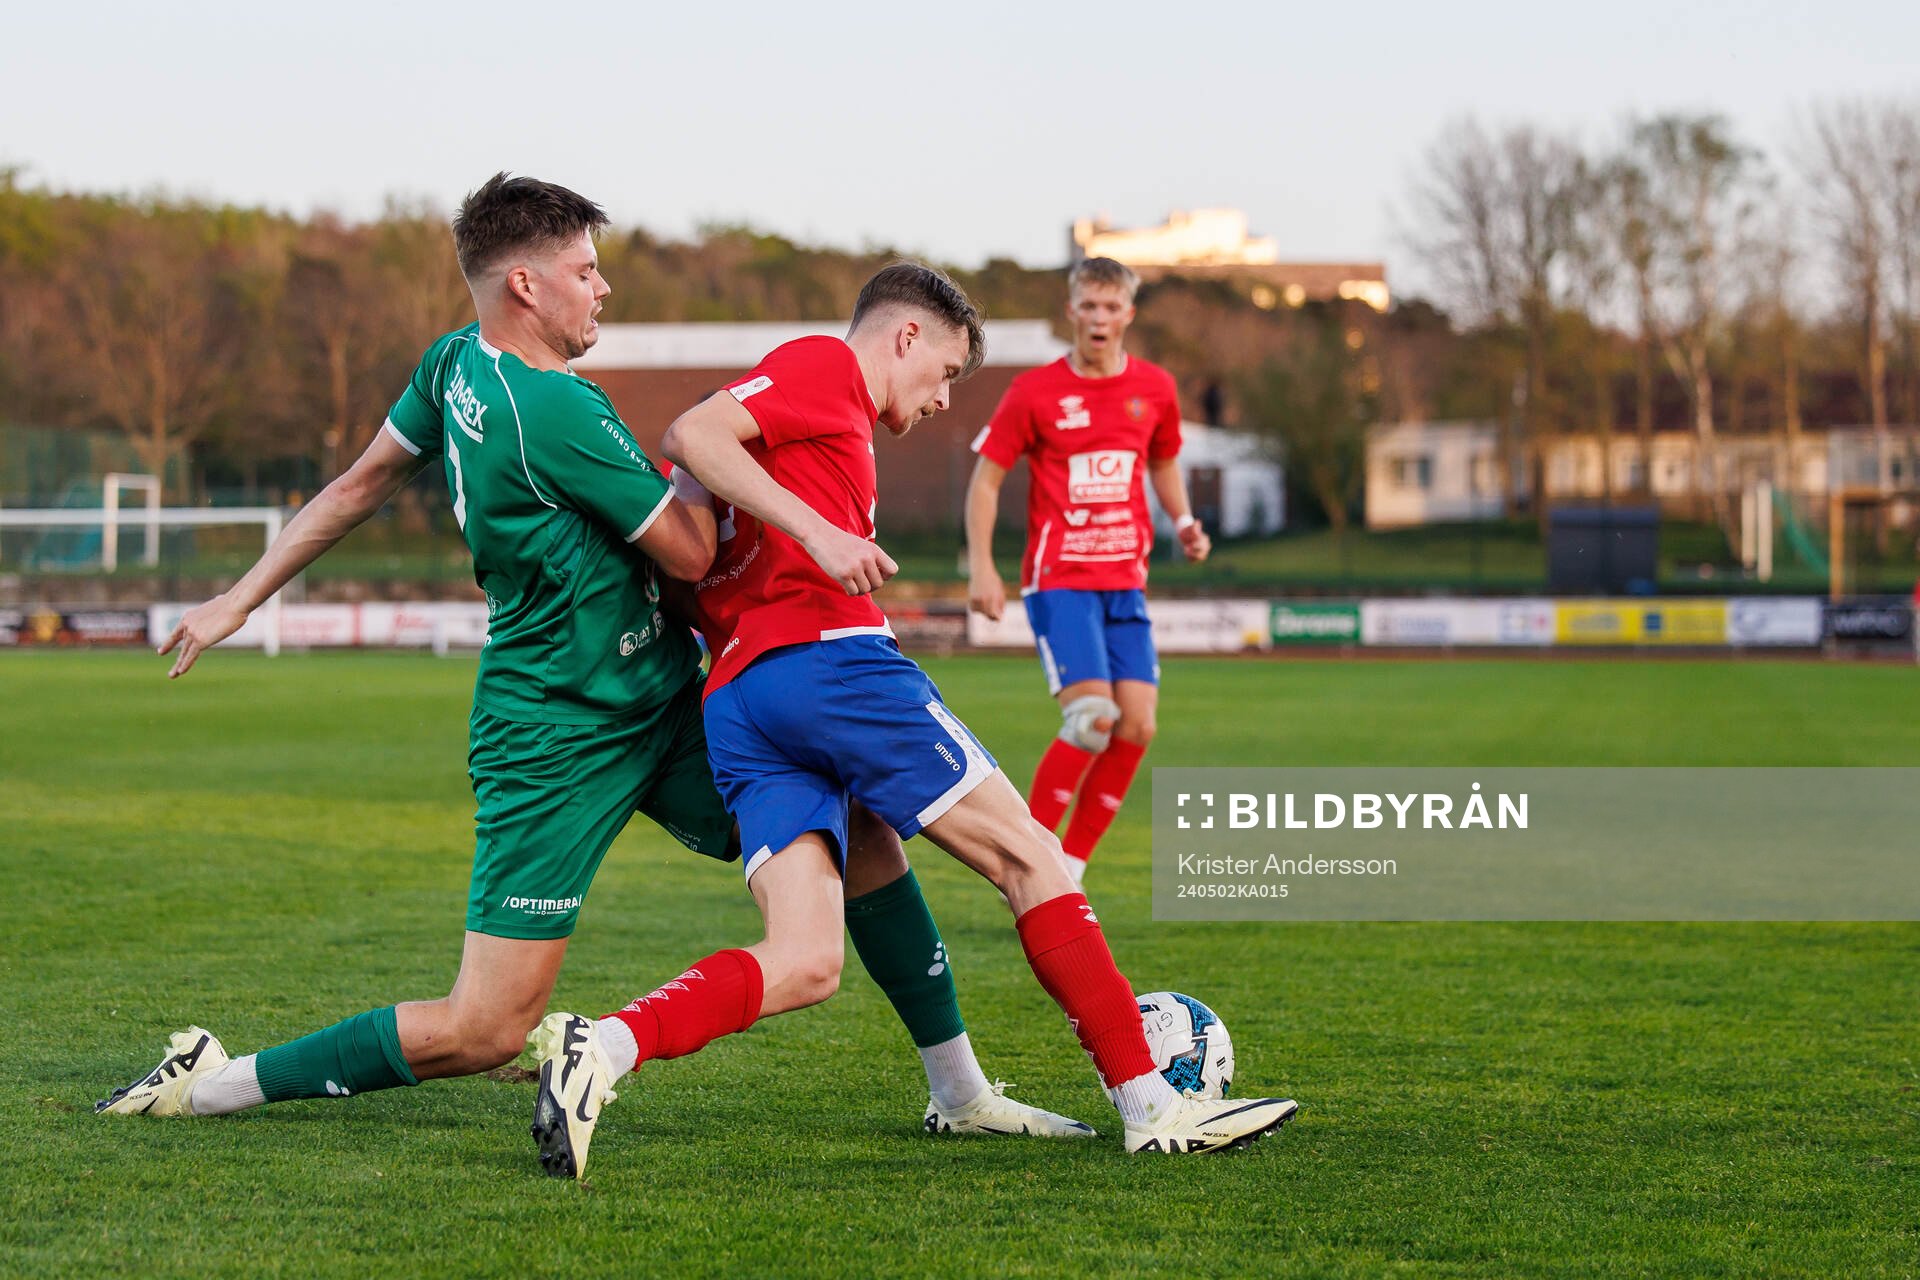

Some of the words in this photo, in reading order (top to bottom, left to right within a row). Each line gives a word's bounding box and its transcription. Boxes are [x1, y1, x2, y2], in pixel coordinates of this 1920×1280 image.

[600, 419, 630, 452] GROUP
[1087, 456, 1123, 478] ICA
[934, 741, 961, 771] umbro
